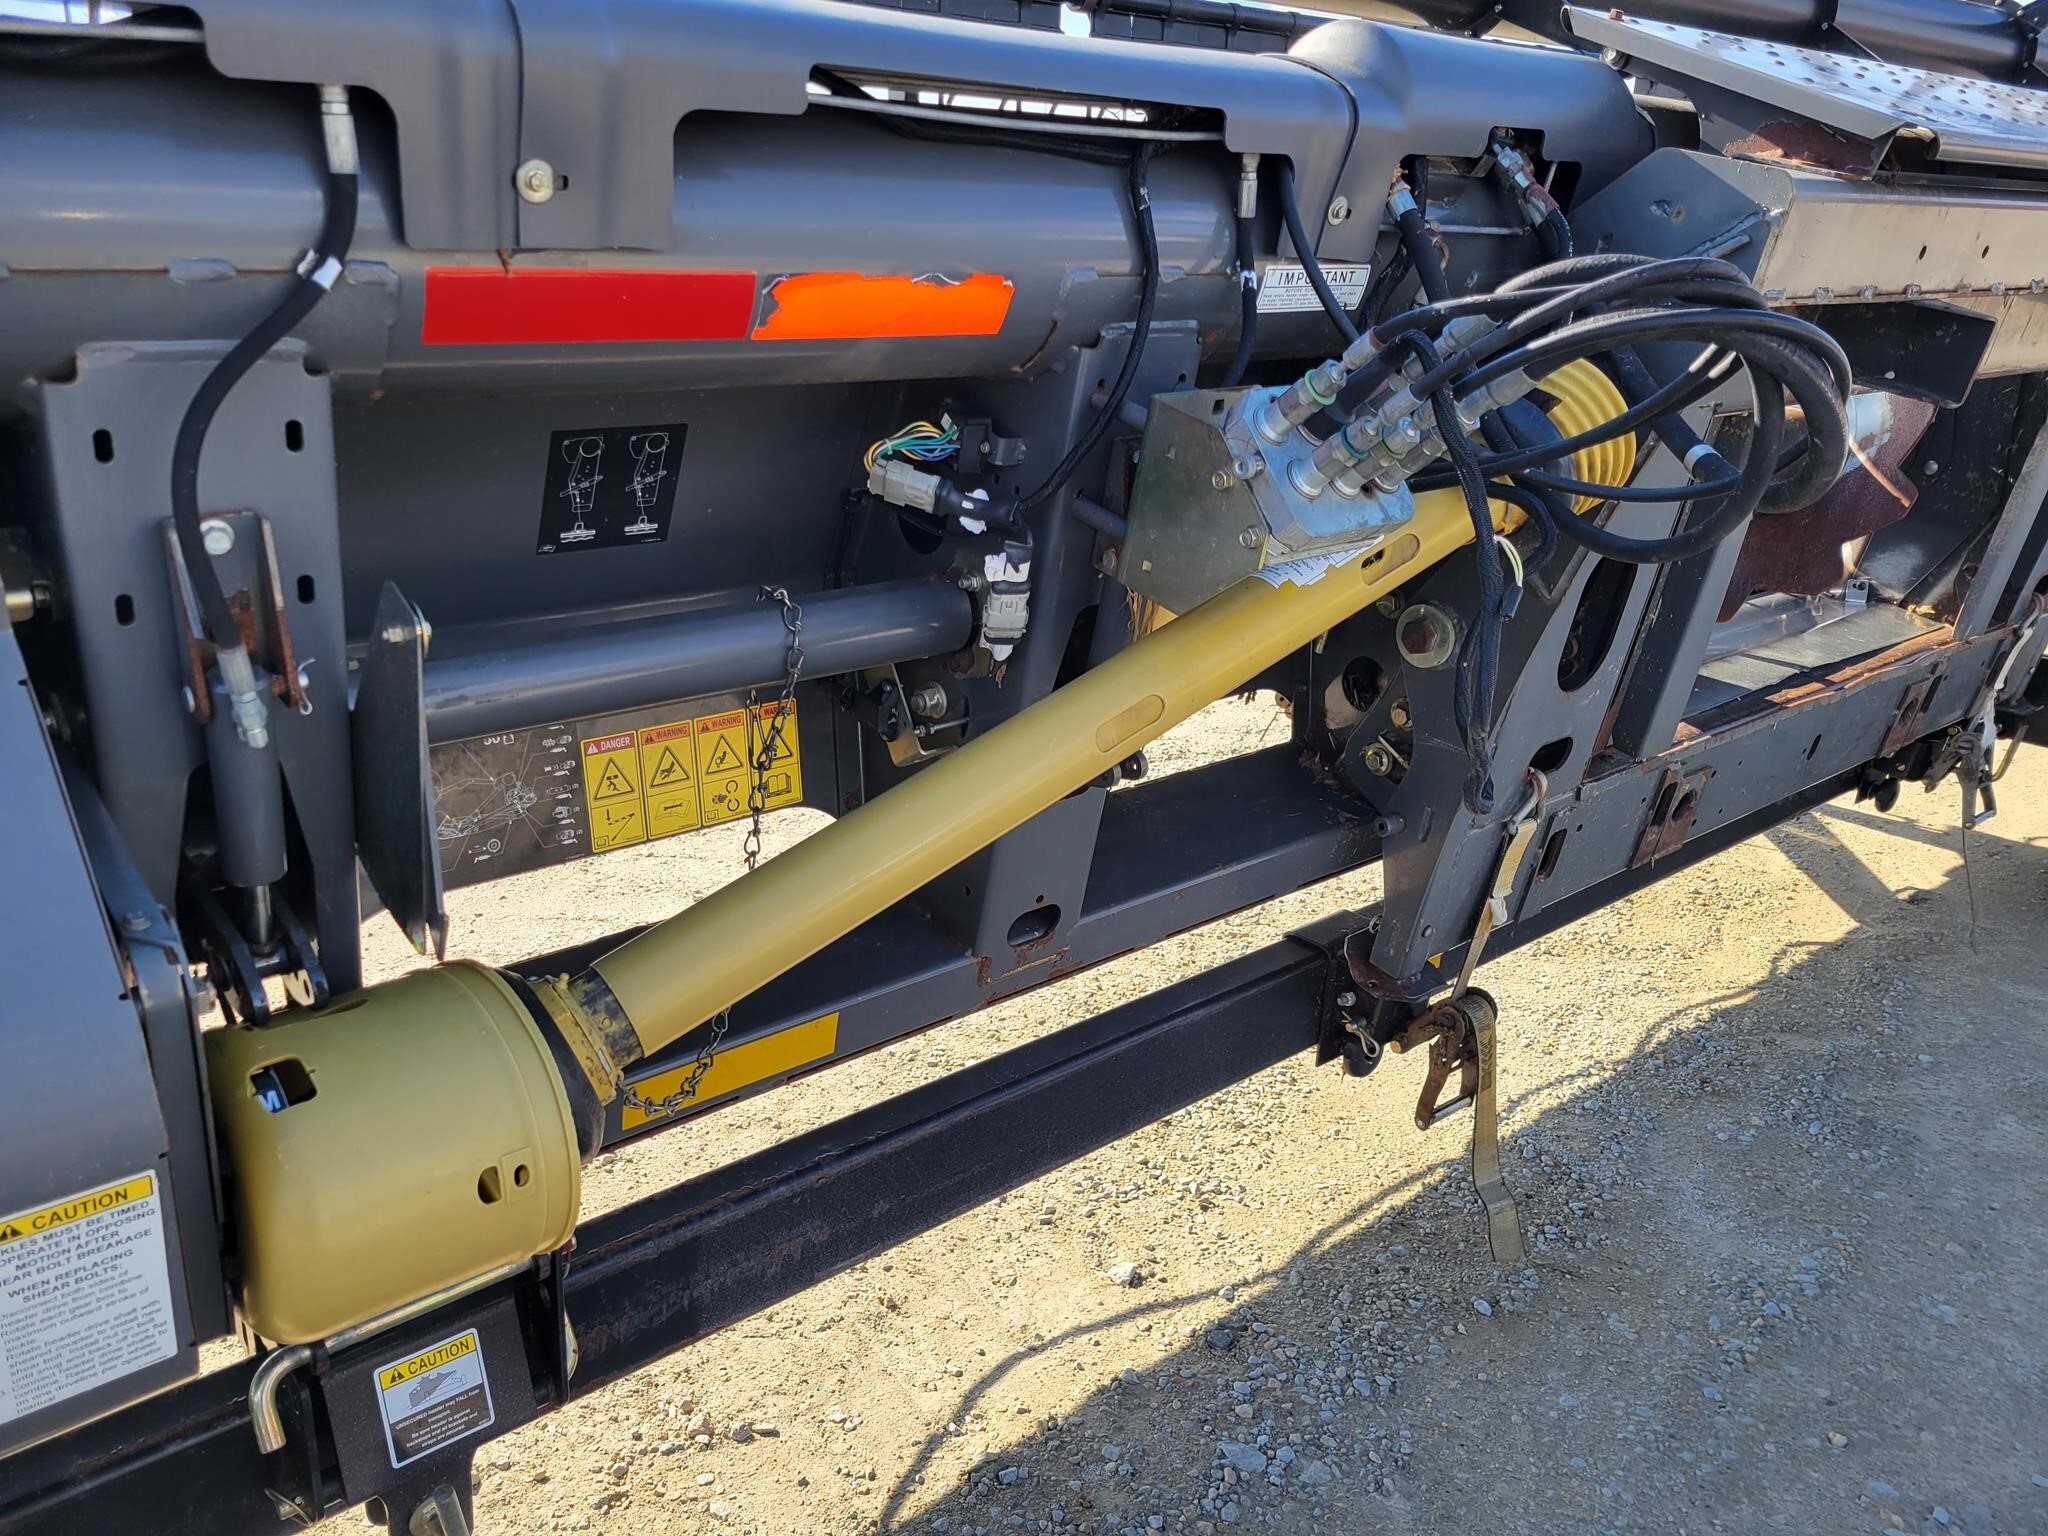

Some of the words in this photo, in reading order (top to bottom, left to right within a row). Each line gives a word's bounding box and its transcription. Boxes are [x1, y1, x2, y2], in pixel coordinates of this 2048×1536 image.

[656, 726, 688, 739] WARNING
[712, 716, 741, 728] WARNING
[600, 738, 631, 750] DANGER
[32, 1188, 129, 1230] CAUTION
[43, 1224, 81, 1242] MUST
[86, 1215, 106, 1228] BE
[110, 1200, 150, 1220] TIMED
[0, 1240, 64, 1268] OPERATE
[68, 1233, 81, 1248] IN
[86, 1208, 156, 1239] OPPOSING
[16, 1248, 71, 1272] MOTION
[76, 1230, 121, 1252] AFTER
[37, 1256, 73, 1275] BOLT
[77, 1228, 153, 1261] BREAKAGE
[8, 1278, 51, 1298] WHEN
[55, 1248, 134, 1282] REPLACING
[23, 1281, 71, 1303] SHEAR
[75, 1264, 123, 1286] BOLTS:
[408, 1338, 470, 1375] CAUTION
[395, 1411, 428, 1431] UNSECURED
[456, 1394, 469, 1403] FALL
